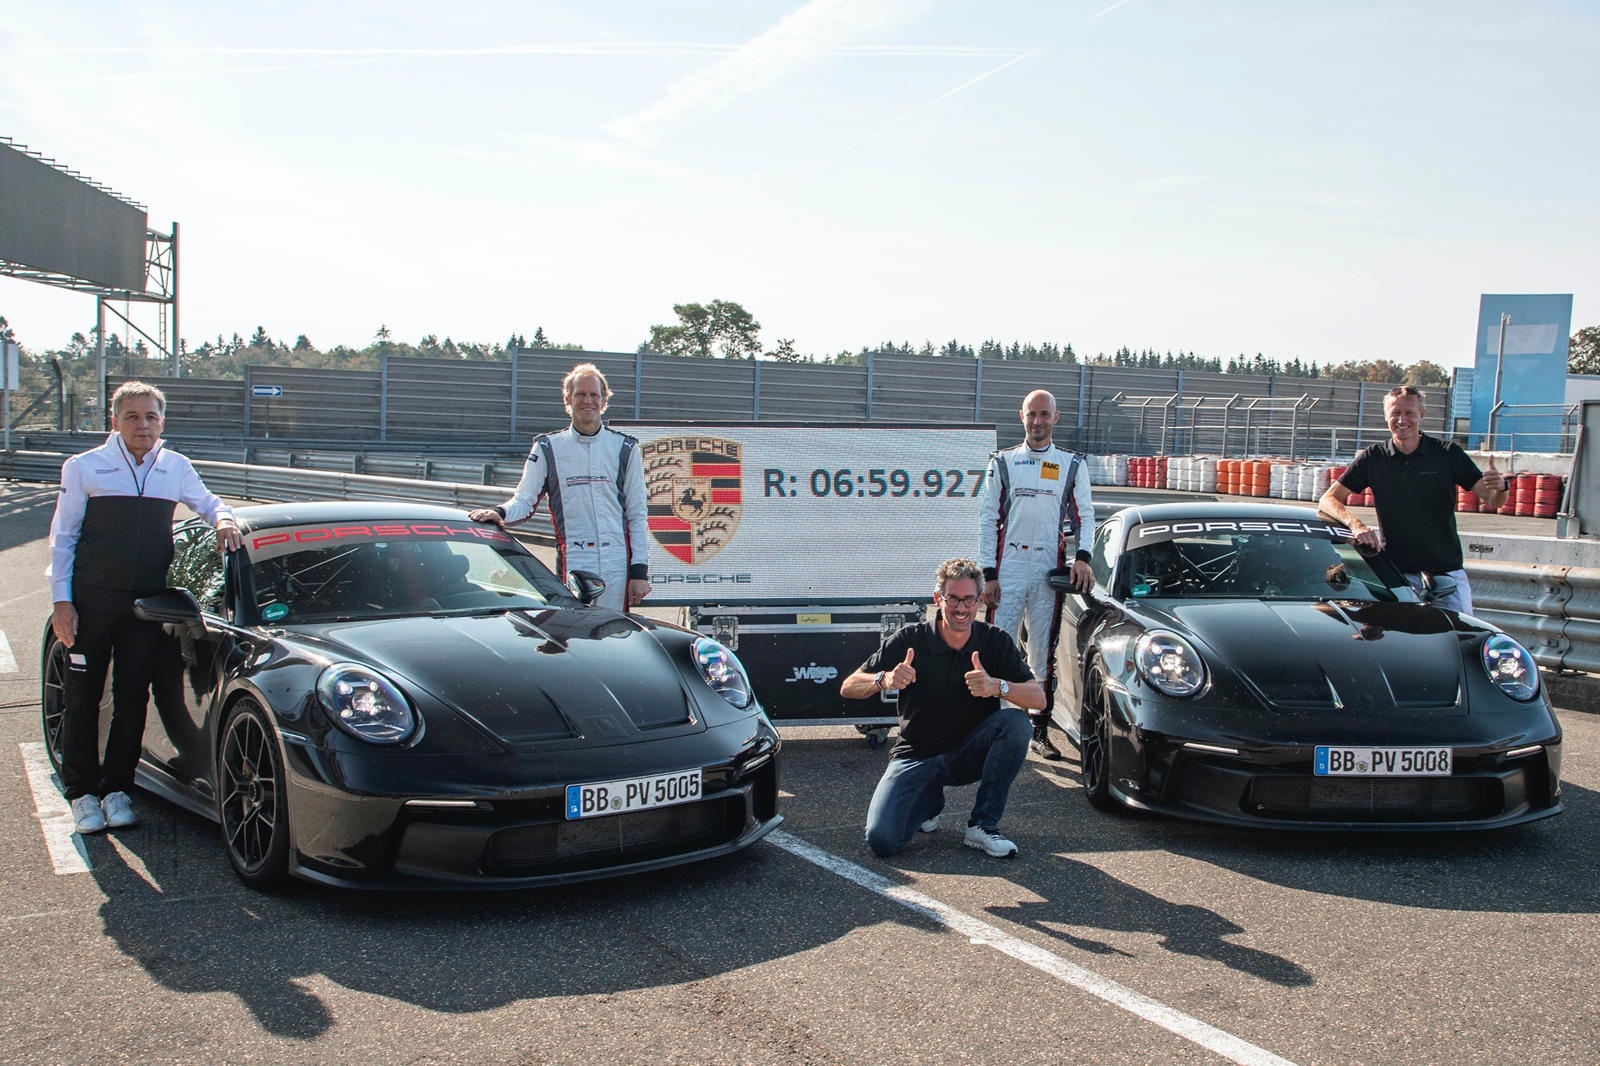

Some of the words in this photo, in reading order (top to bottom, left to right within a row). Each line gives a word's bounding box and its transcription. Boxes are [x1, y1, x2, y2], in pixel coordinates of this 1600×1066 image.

[642, 440, 738, 458] PORSCHE
[763, 468, 797, 497] R:
[810, 468, 986, 498] 06:59.927
[252, 525, 511, 550] PORSCHE
[1139, 522, 1357, 539] PORSCHE
[648, 574, 752, 584] ORSCHE
[1329, 750, 1355, 772] BB
[1371, 750, 1397, 772] PV
[1401, 750, 1449, 772] 5008
[582, 787, 609, 813] BB
[625, 781, 650, 807] PV
[655, 773, 699, 802] 5005
